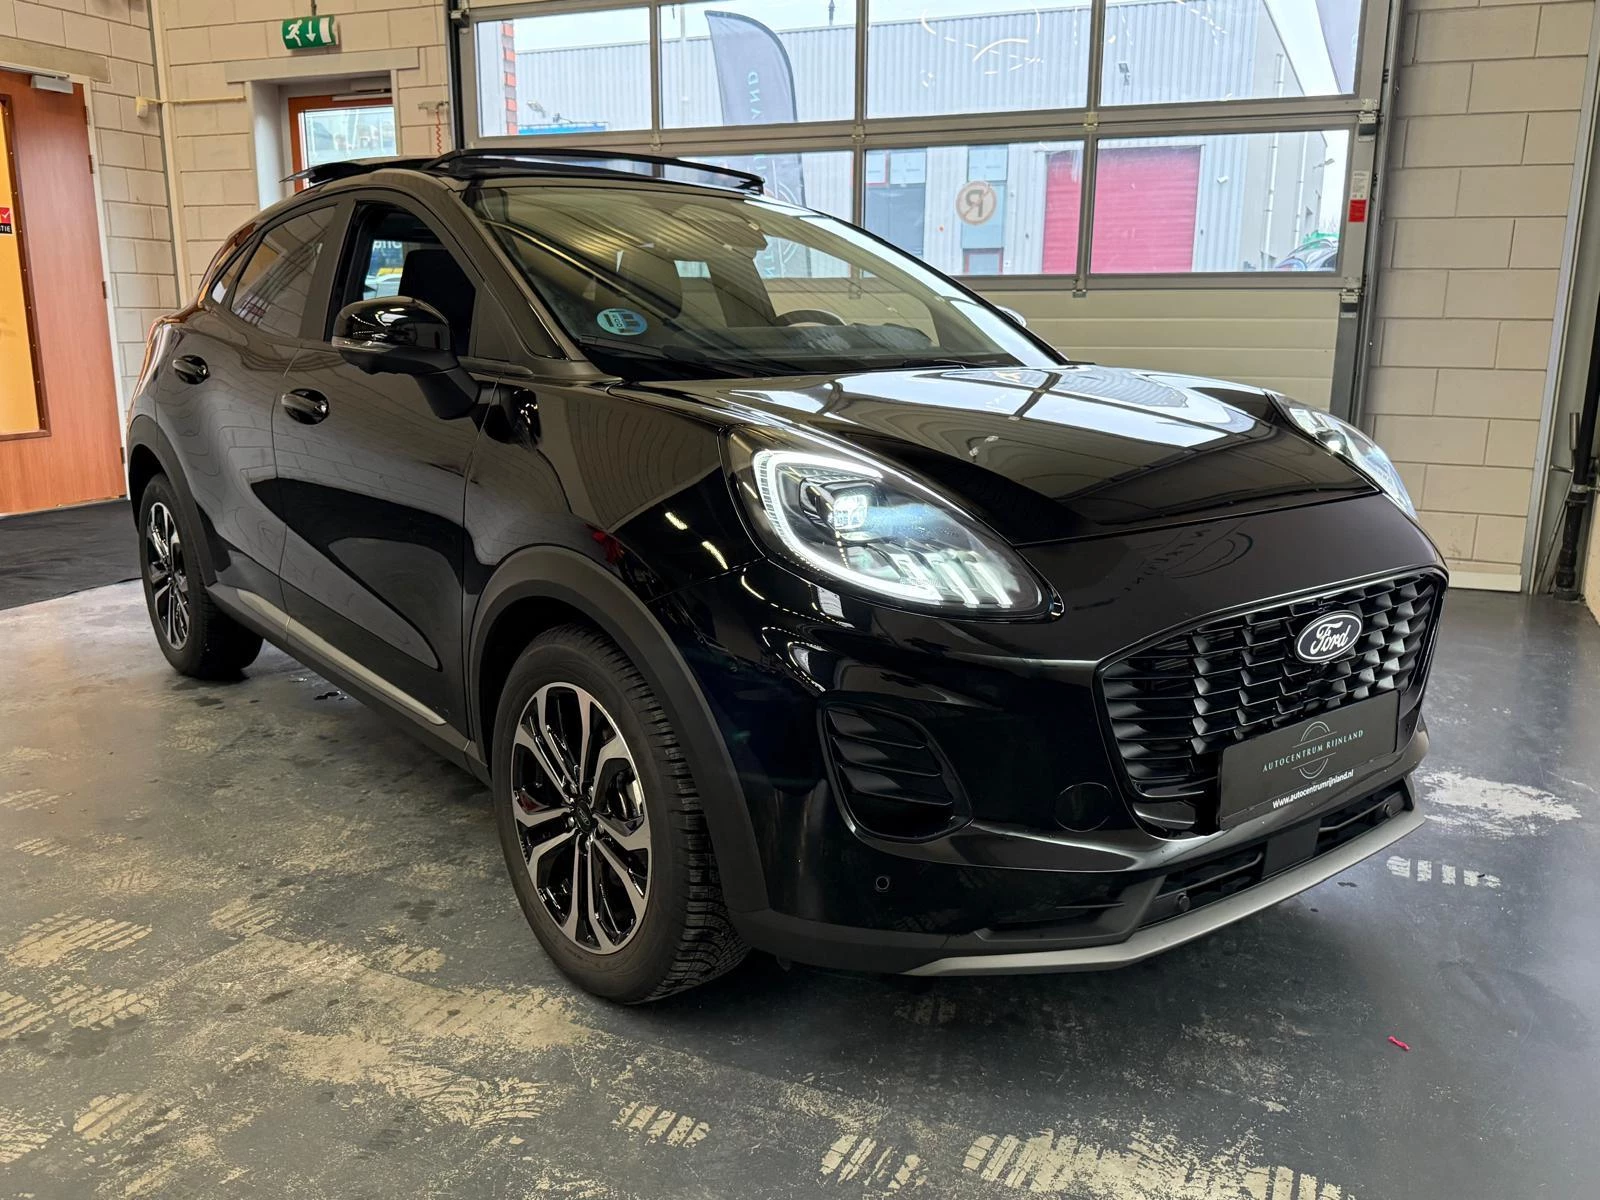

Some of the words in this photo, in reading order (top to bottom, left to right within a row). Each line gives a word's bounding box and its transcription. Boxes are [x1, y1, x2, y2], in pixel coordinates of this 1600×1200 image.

[1310, 620, 1350, 654] Ford
[1263, 745, 1324, 772] AUTOCENTRUM
[1327, 729, 1364, 749] RIJNLAND
